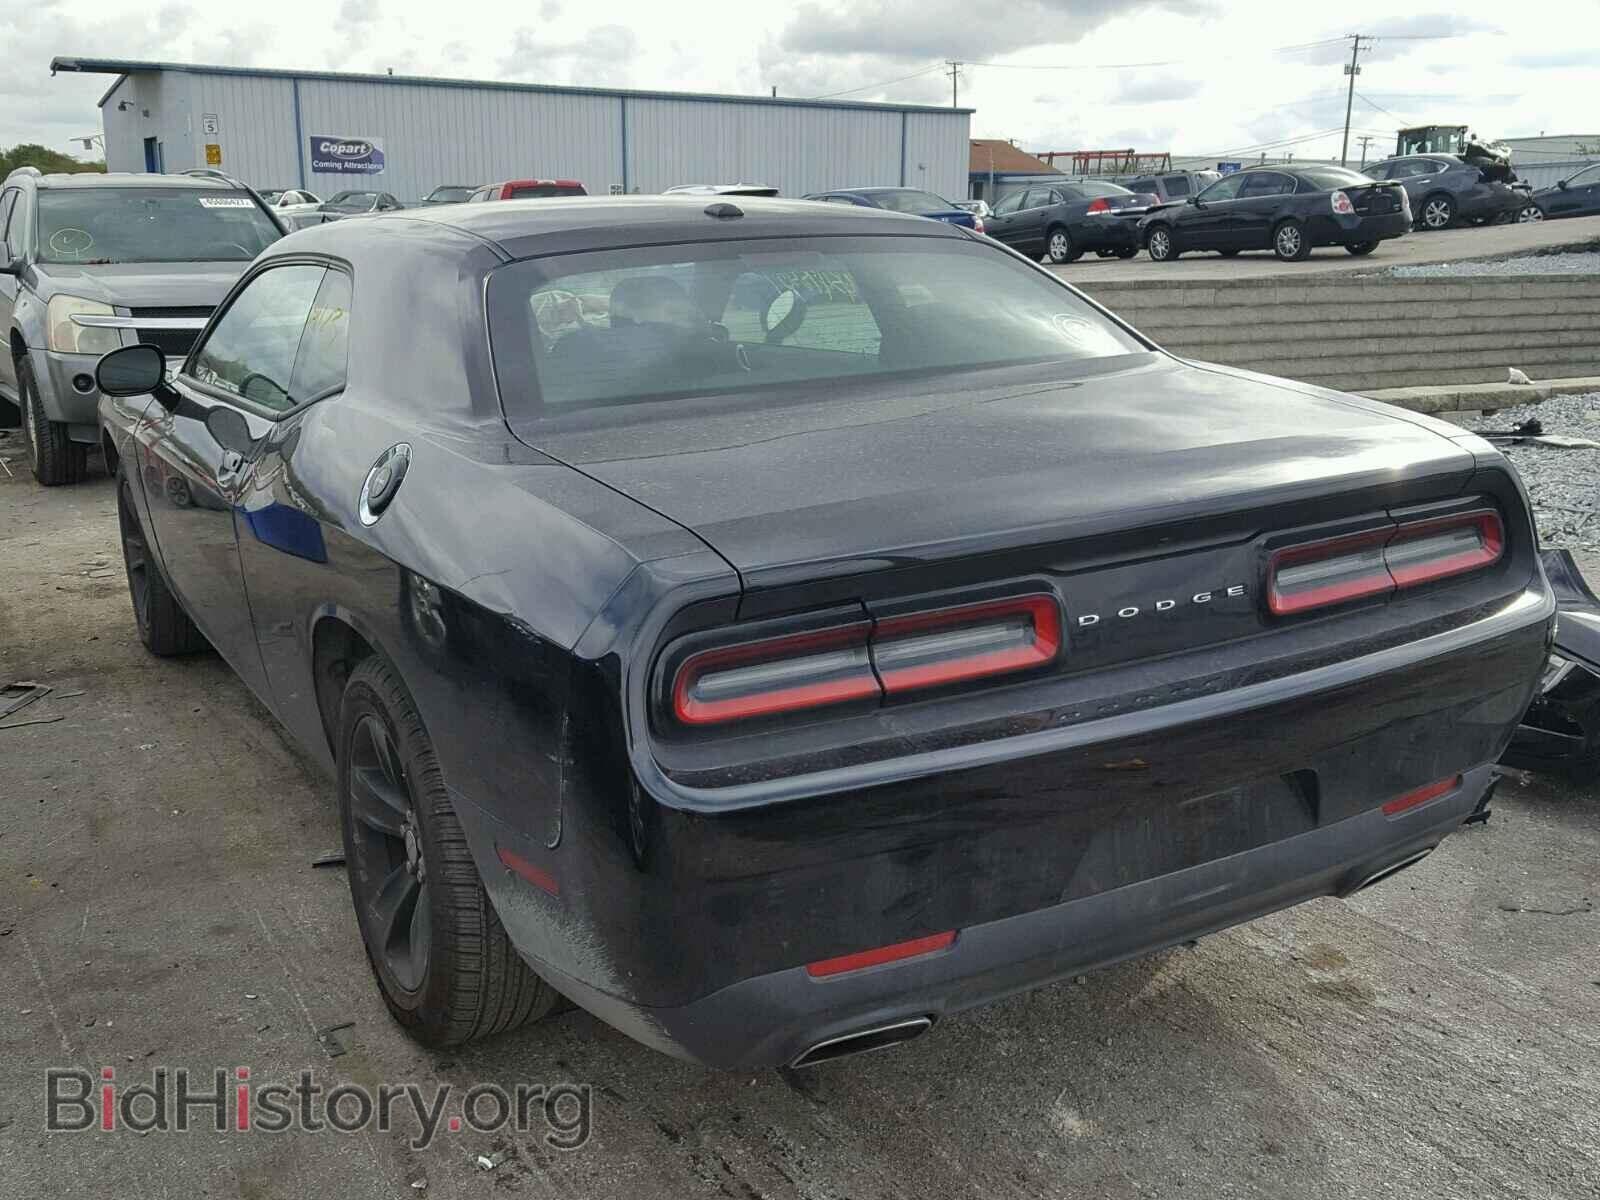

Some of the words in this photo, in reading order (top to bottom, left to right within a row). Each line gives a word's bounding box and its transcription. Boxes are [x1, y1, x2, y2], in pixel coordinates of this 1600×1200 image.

[207, 124, 215, 132] 5
[320, 141, 367, 155] Copart
[312, 160, 342, 170] Coming
[343, 161, 384, 170] Attractions
[1078, 585, 1245, 627] DODGE
